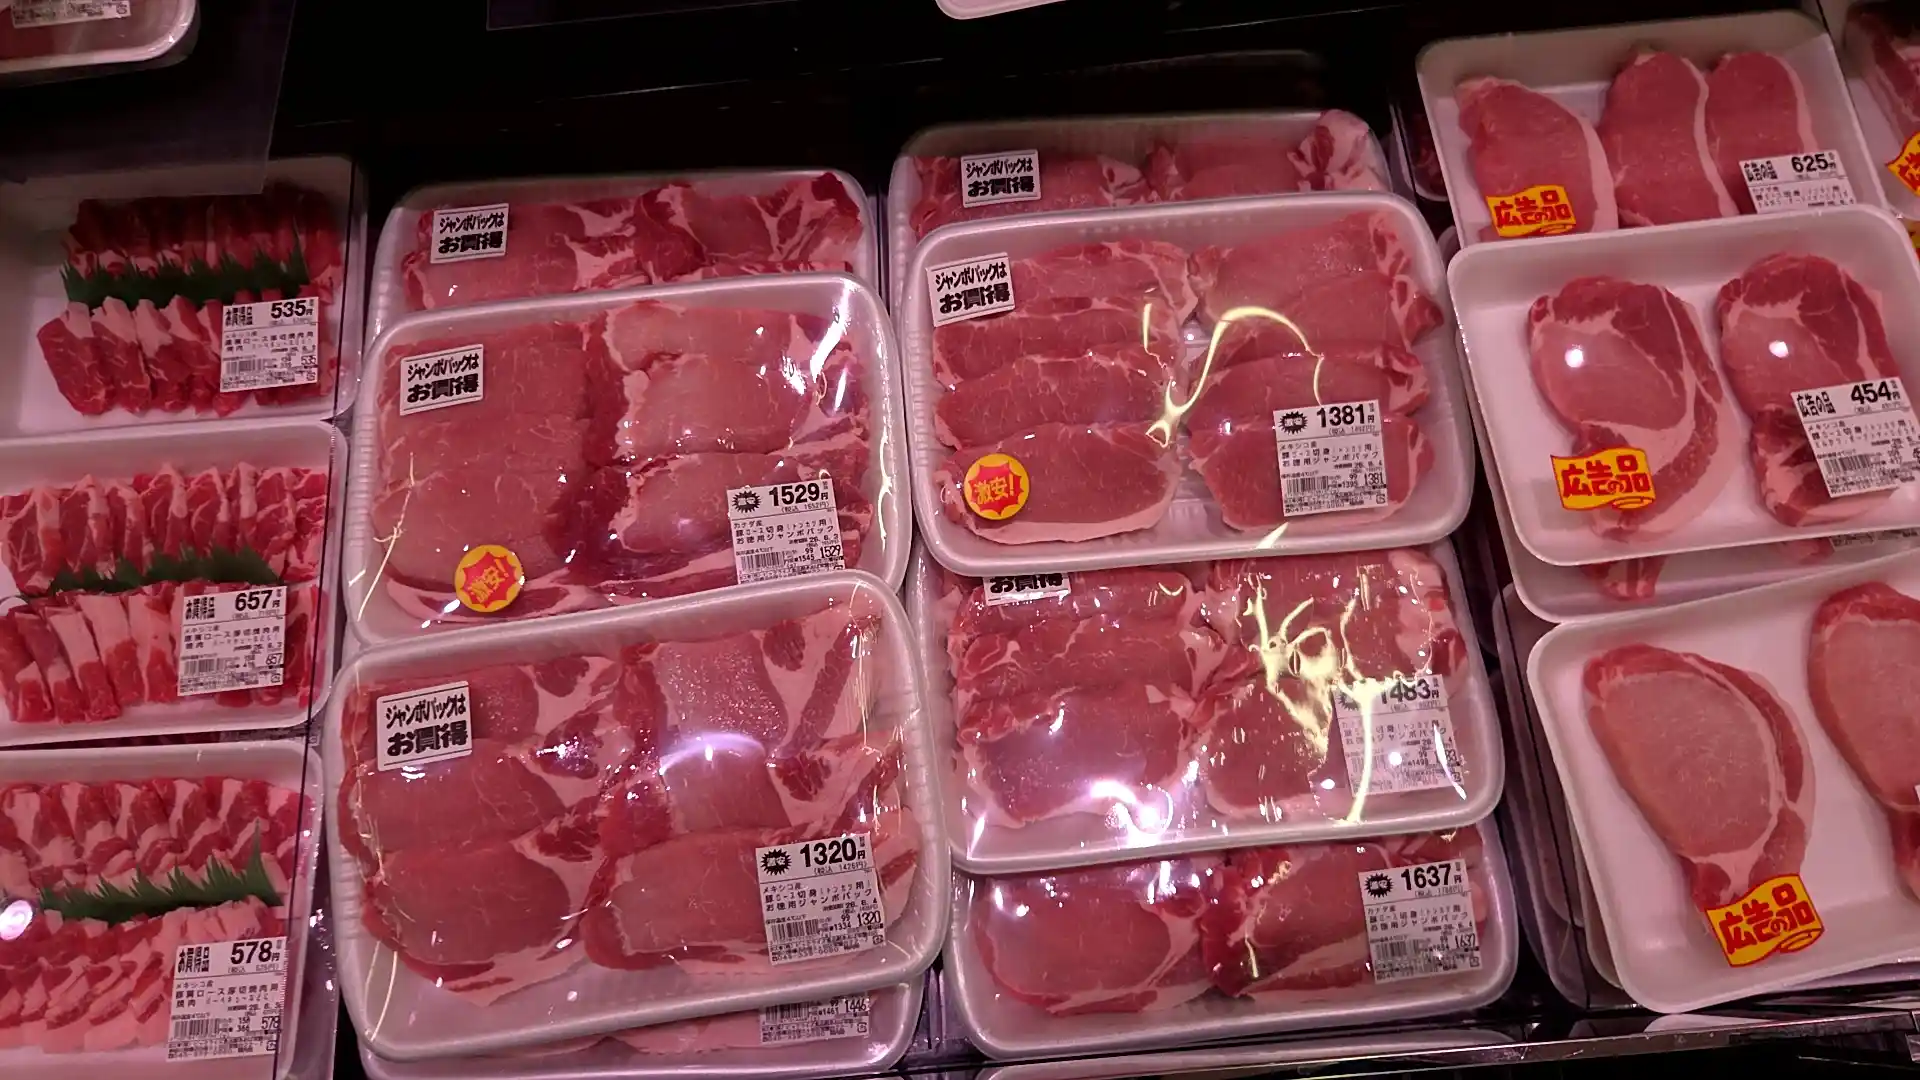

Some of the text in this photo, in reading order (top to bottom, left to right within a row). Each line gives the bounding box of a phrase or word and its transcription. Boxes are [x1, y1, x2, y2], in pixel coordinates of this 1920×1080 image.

[966, 158, 1033, 178] ジャンボパックは
[967, 176, 1034, 197] お買得
[1494, 190, 1572, 228] 広告の品
[440, 212, 504, 233] ジャンボパックは
[439, 231, 503, 253] お買得
[935, 262, 1007, 292] ジャンボパックは
[940, 282, 1010, 314] お買得
[407, 353, 479, 382] ジャンボパックは
[407, 373, 478, 403] お買得
[1363, 471, 1384, 486] 1381
[1561, 454, 1651, 498] 広告の品
[974, 472, 1015, 504] 激安!
[819, 544, 841, 558] 1529
[265, 652, 282, 666] 657
[386, 693, 466, 729] ジャンボパックは
[387, 720, 468, 756] お買得
[856, 909, 881, 927] 1320
[1719, 883, 1816, 955] 広告の品
[1454, 932, 1475, 949] 1637
[845, 999, 867, 1013] 1446
[260, 1014, 280, 1030] 578
